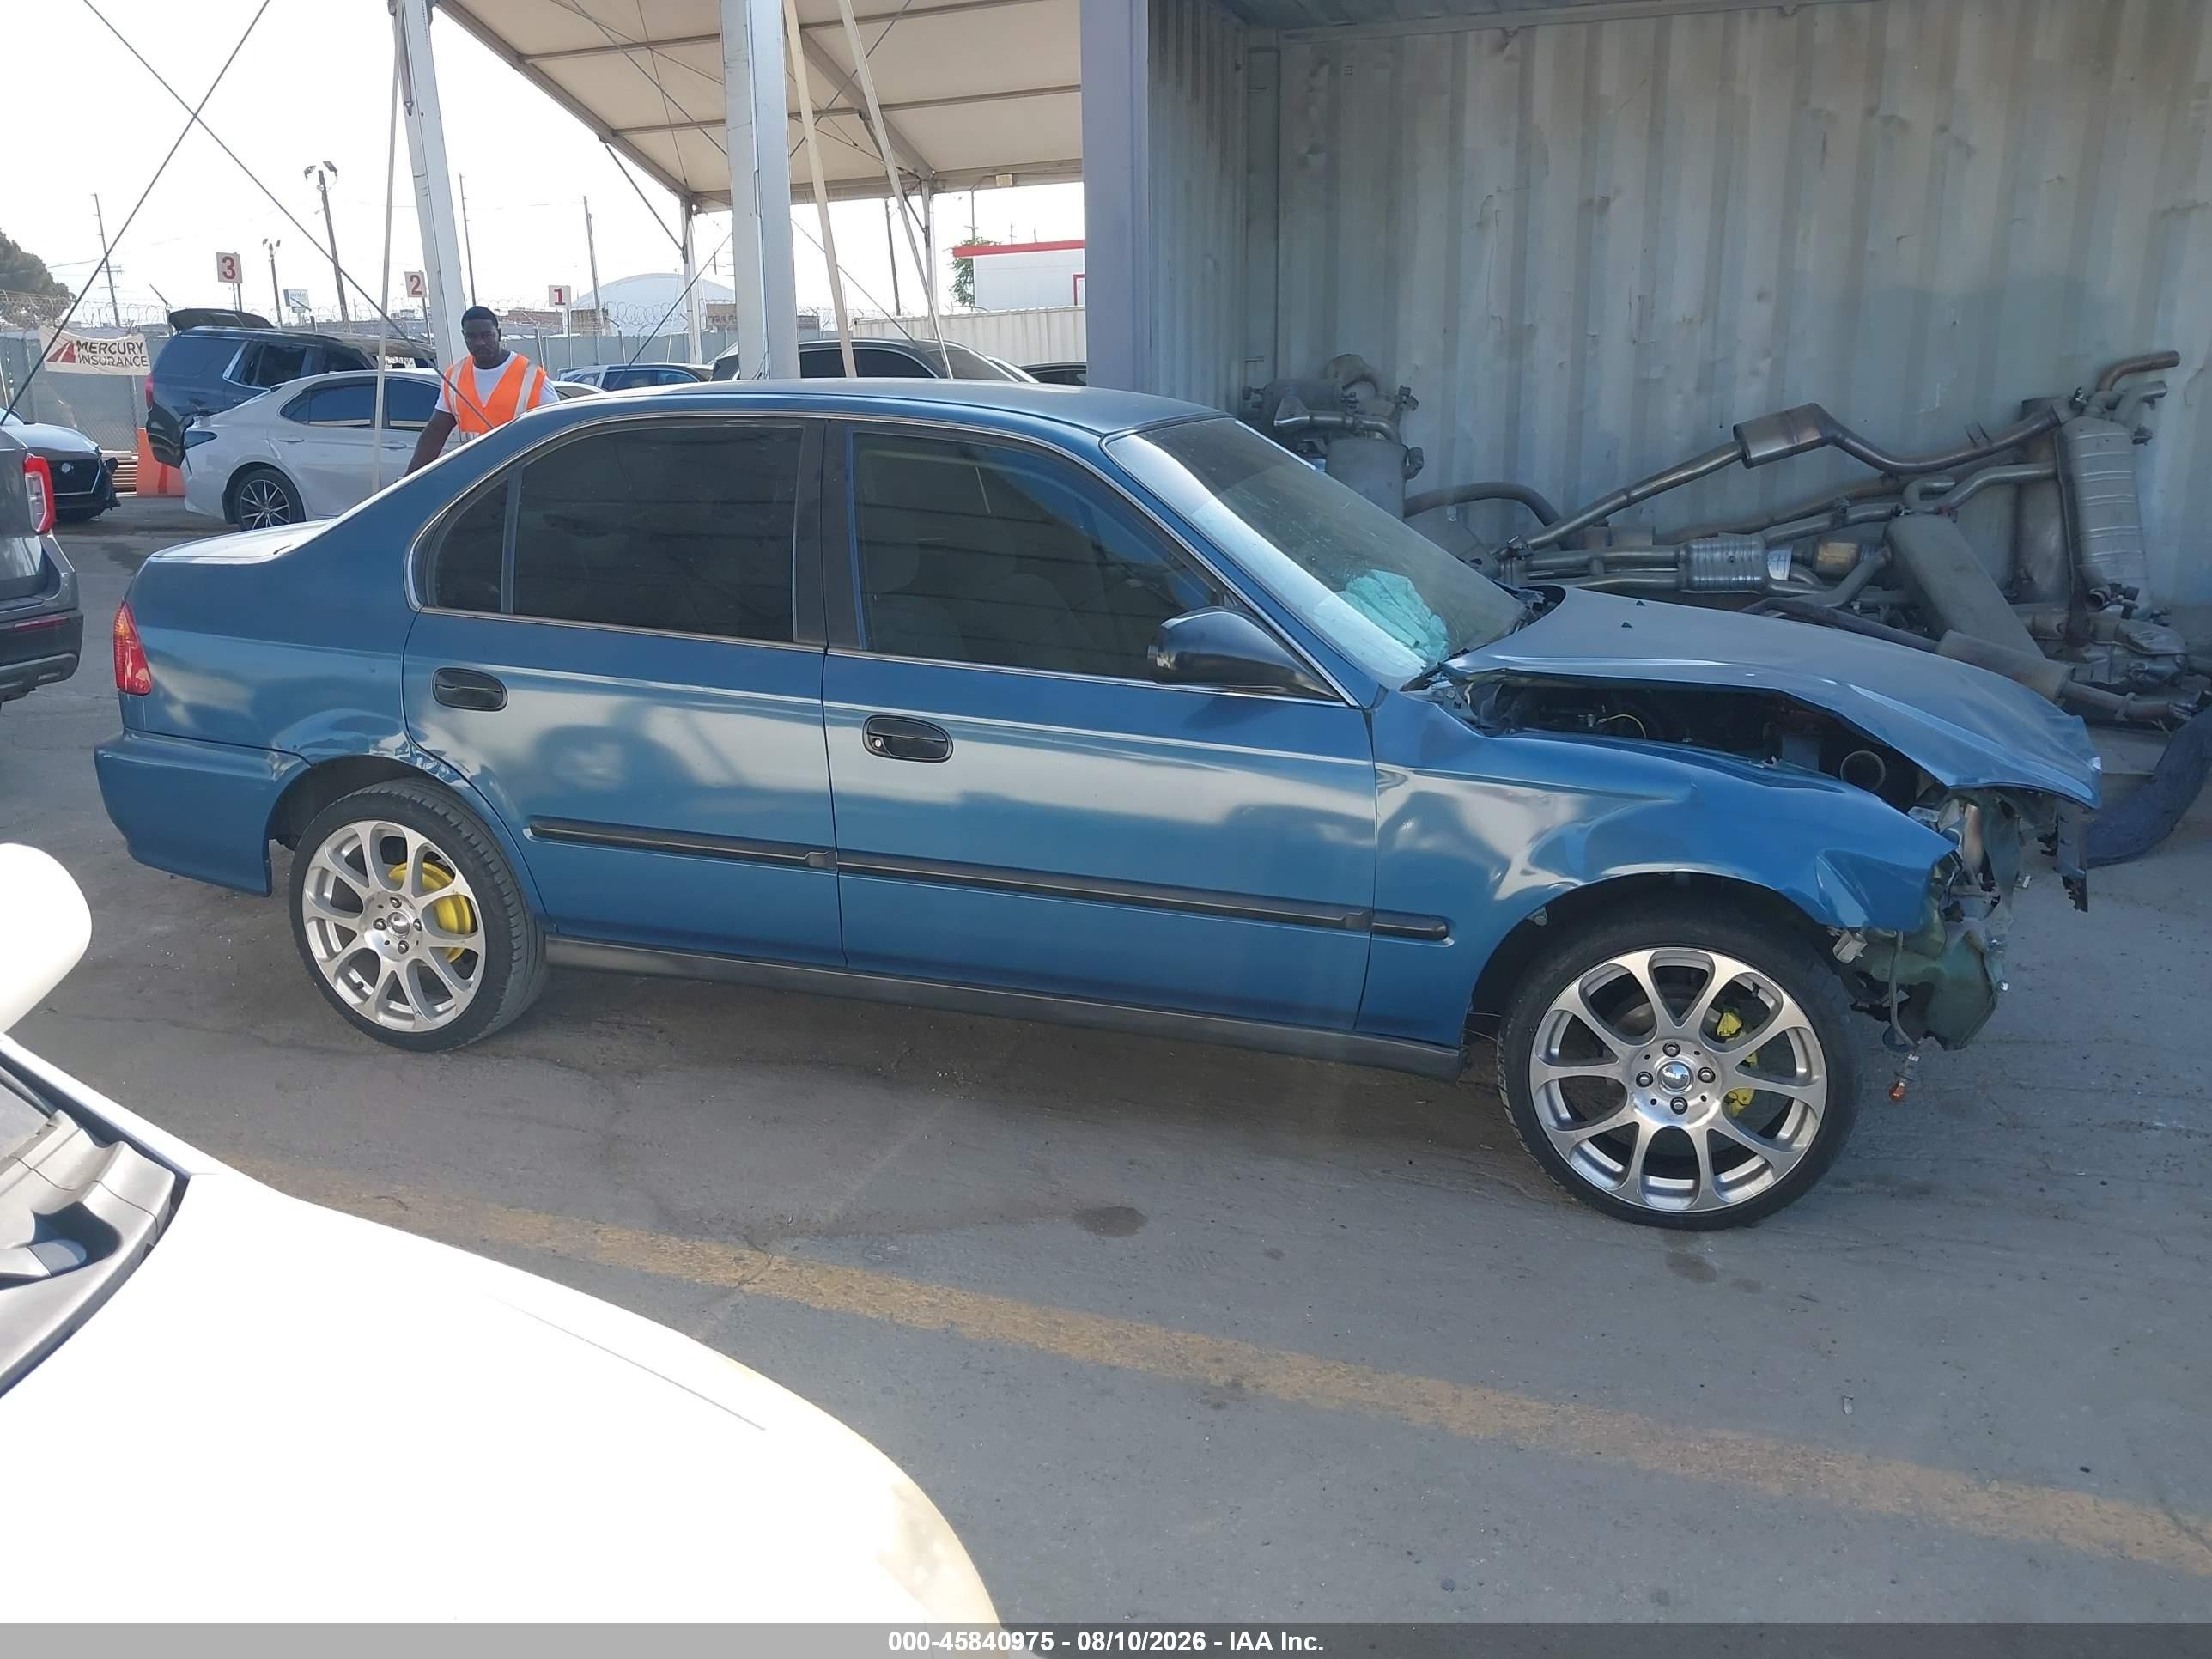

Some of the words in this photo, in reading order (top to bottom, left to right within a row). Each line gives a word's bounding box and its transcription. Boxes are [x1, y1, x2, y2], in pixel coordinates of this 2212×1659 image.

[222, 256, 235, 279] 3
[410, 275, 422, 295] 2
[554, 288, 565, 305] 1
[76, 340, 144, 355] MERCURY
[78, 354, 149, 367] INSURANCE
